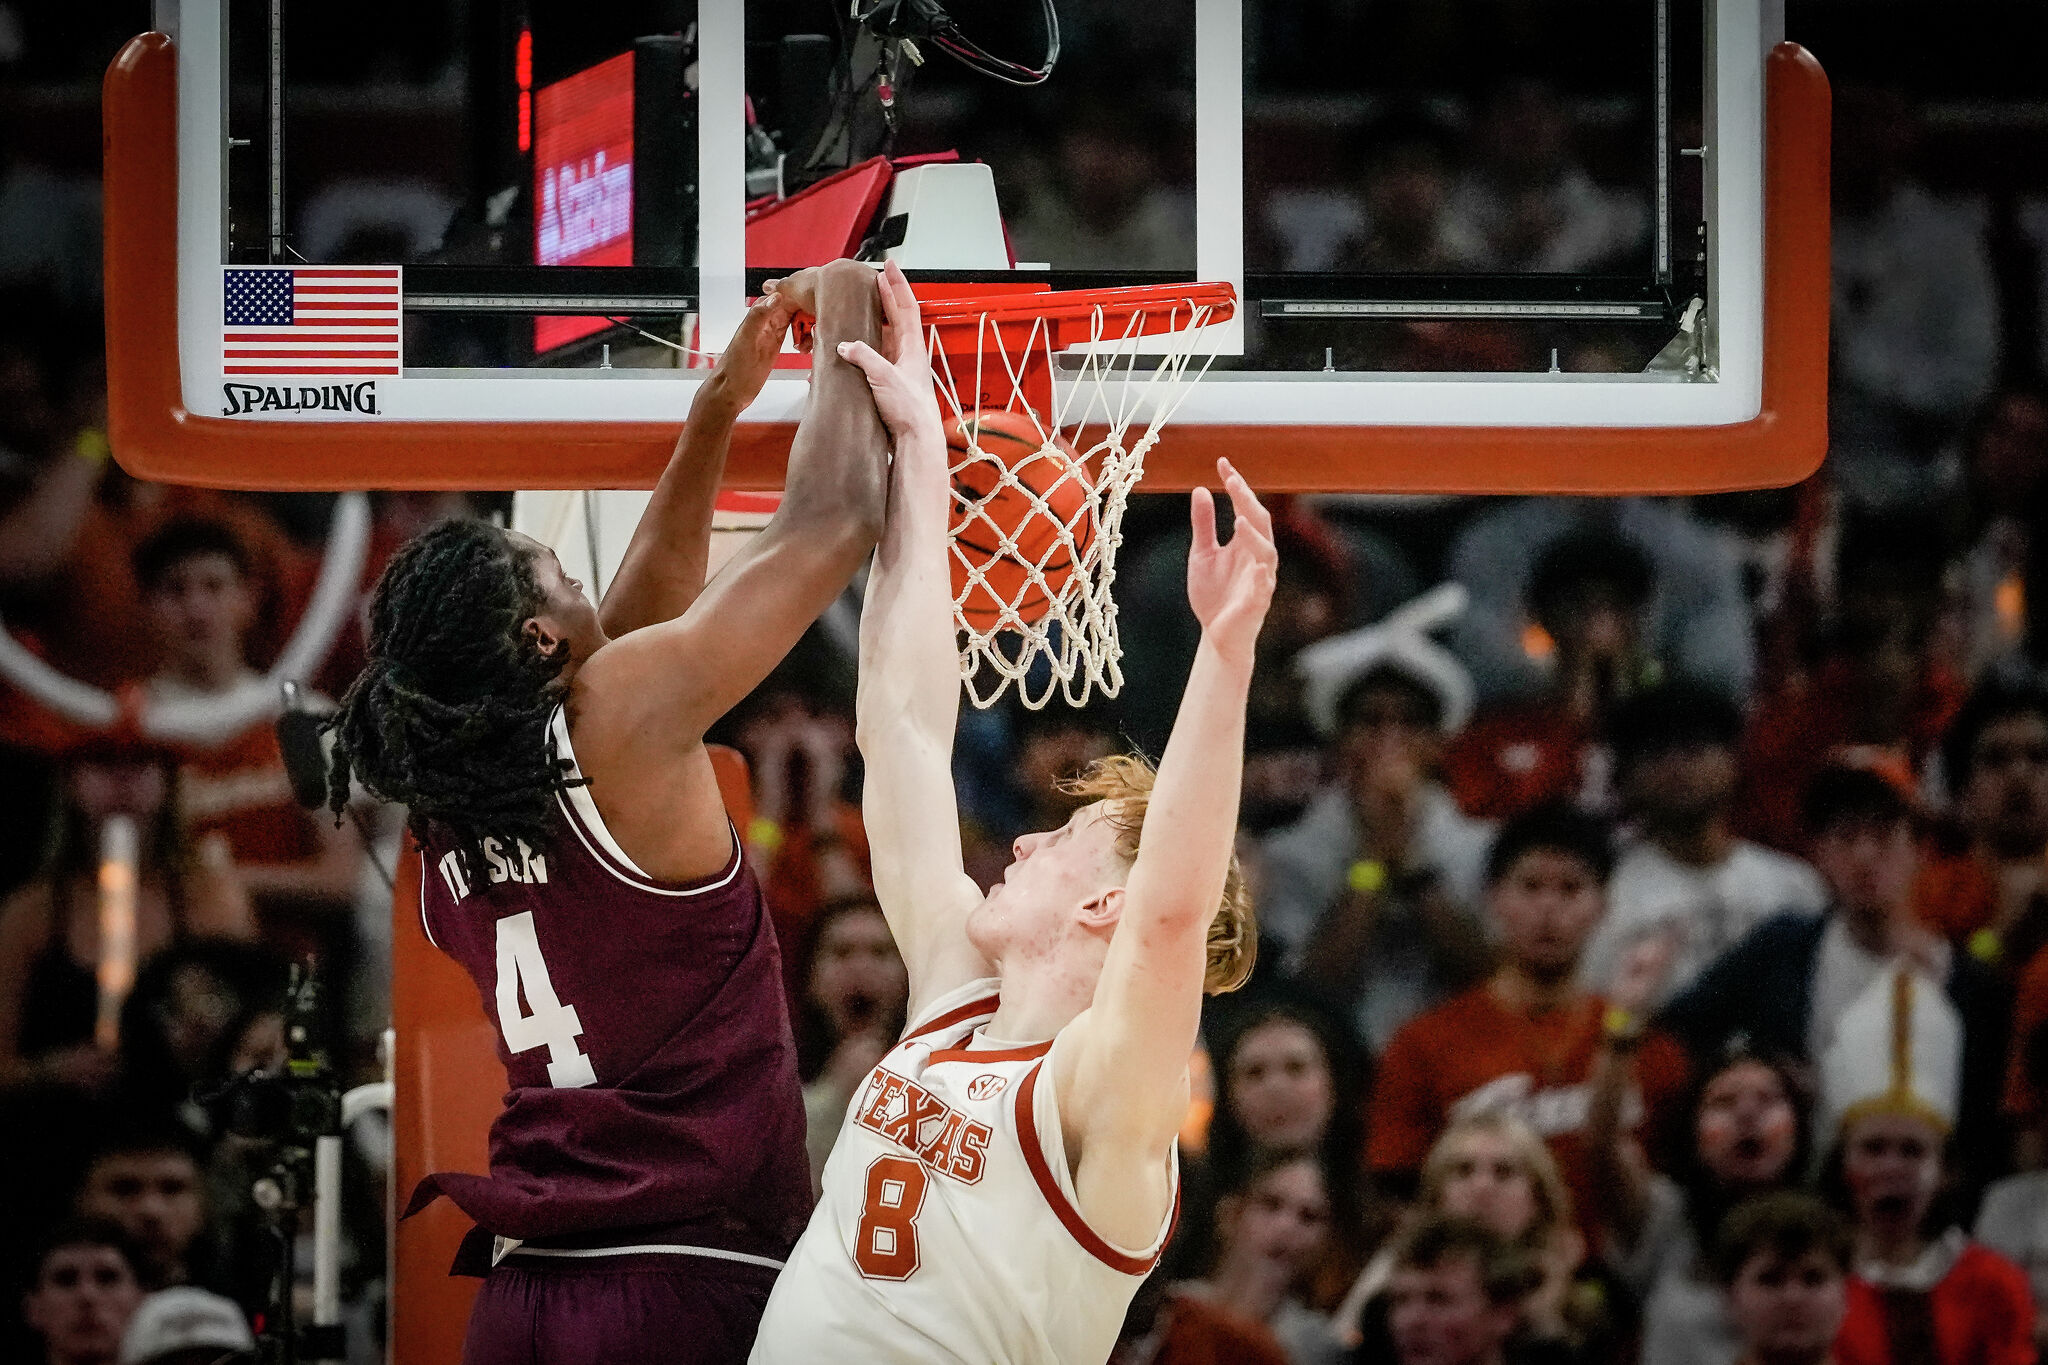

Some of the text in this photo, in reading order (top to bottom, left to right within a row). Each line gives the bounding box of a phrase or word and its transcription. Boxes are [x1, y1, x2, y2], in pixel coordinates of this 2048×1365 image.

[223, 381, 376, 416] SPALDING
[496, 911, 598, 1089] 4
[853, 1153, 930, 1282] 8
